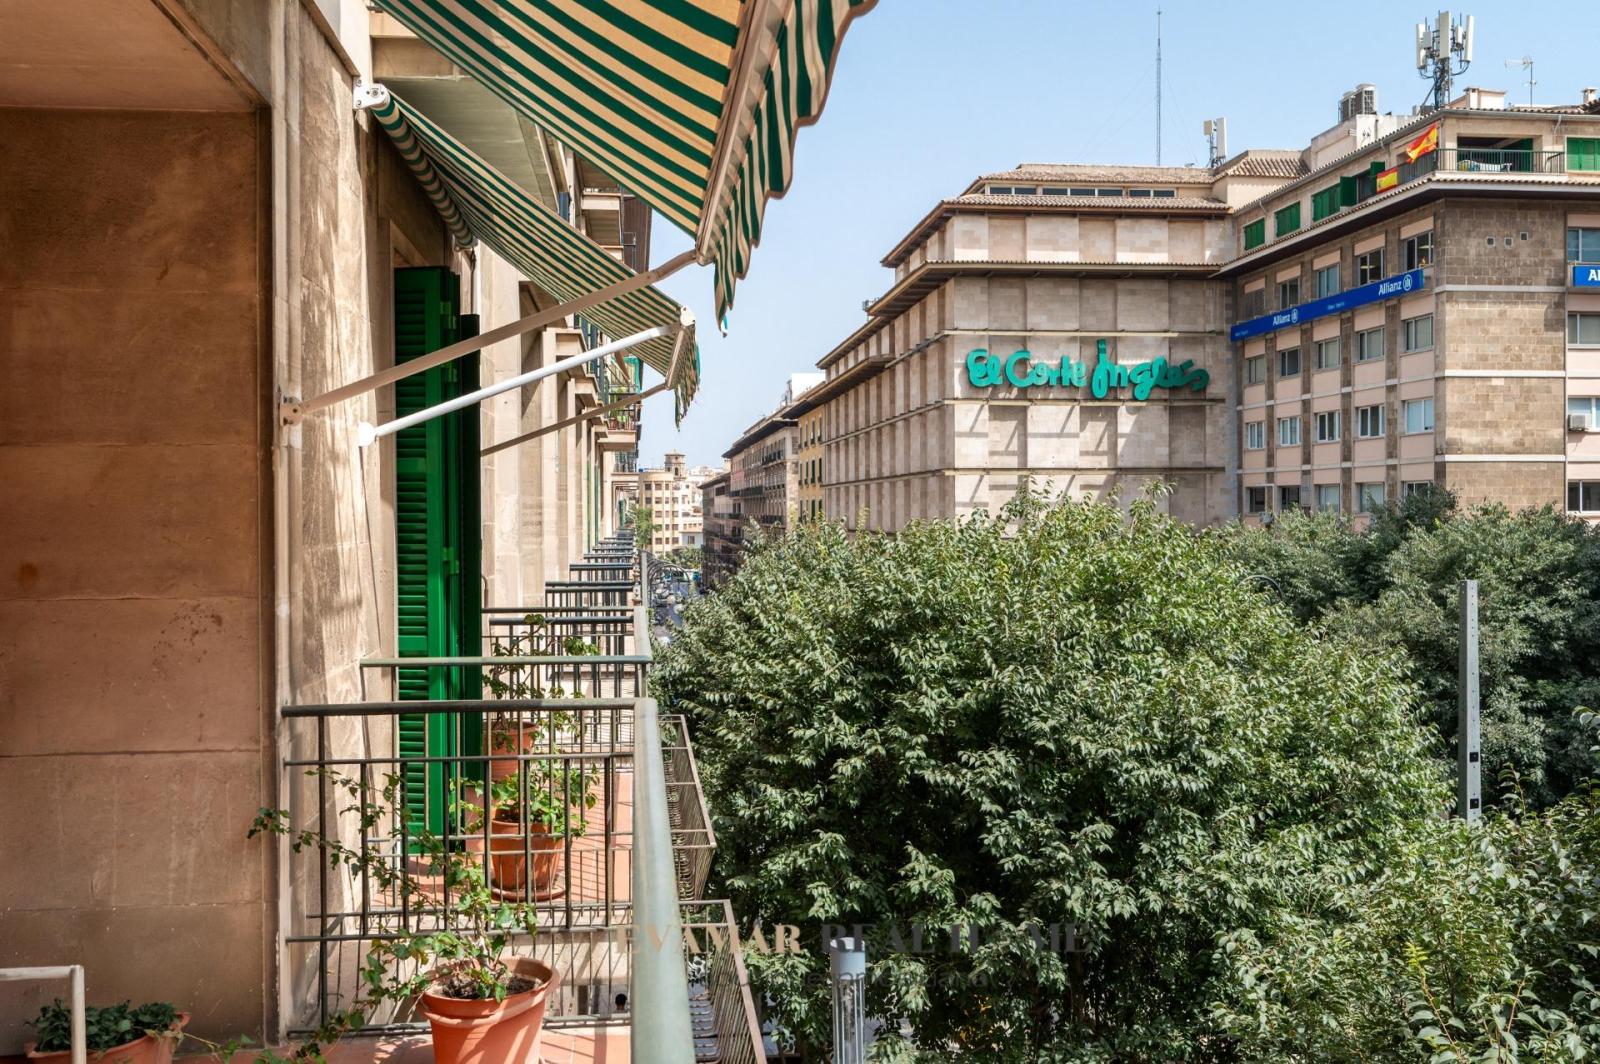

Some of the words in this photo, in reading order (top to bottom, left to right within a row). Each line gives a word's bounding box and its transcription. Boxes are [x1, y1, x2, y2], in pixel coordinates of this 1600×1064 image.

[1378, 280, 1402, 295] Allianz
[1272, 314, 1291, 326] Allianz
[966, 348, 1004, 388] El
[1005, 350, 1087, 388] Corte
[1091, 338, 1210, 401] Inglés
